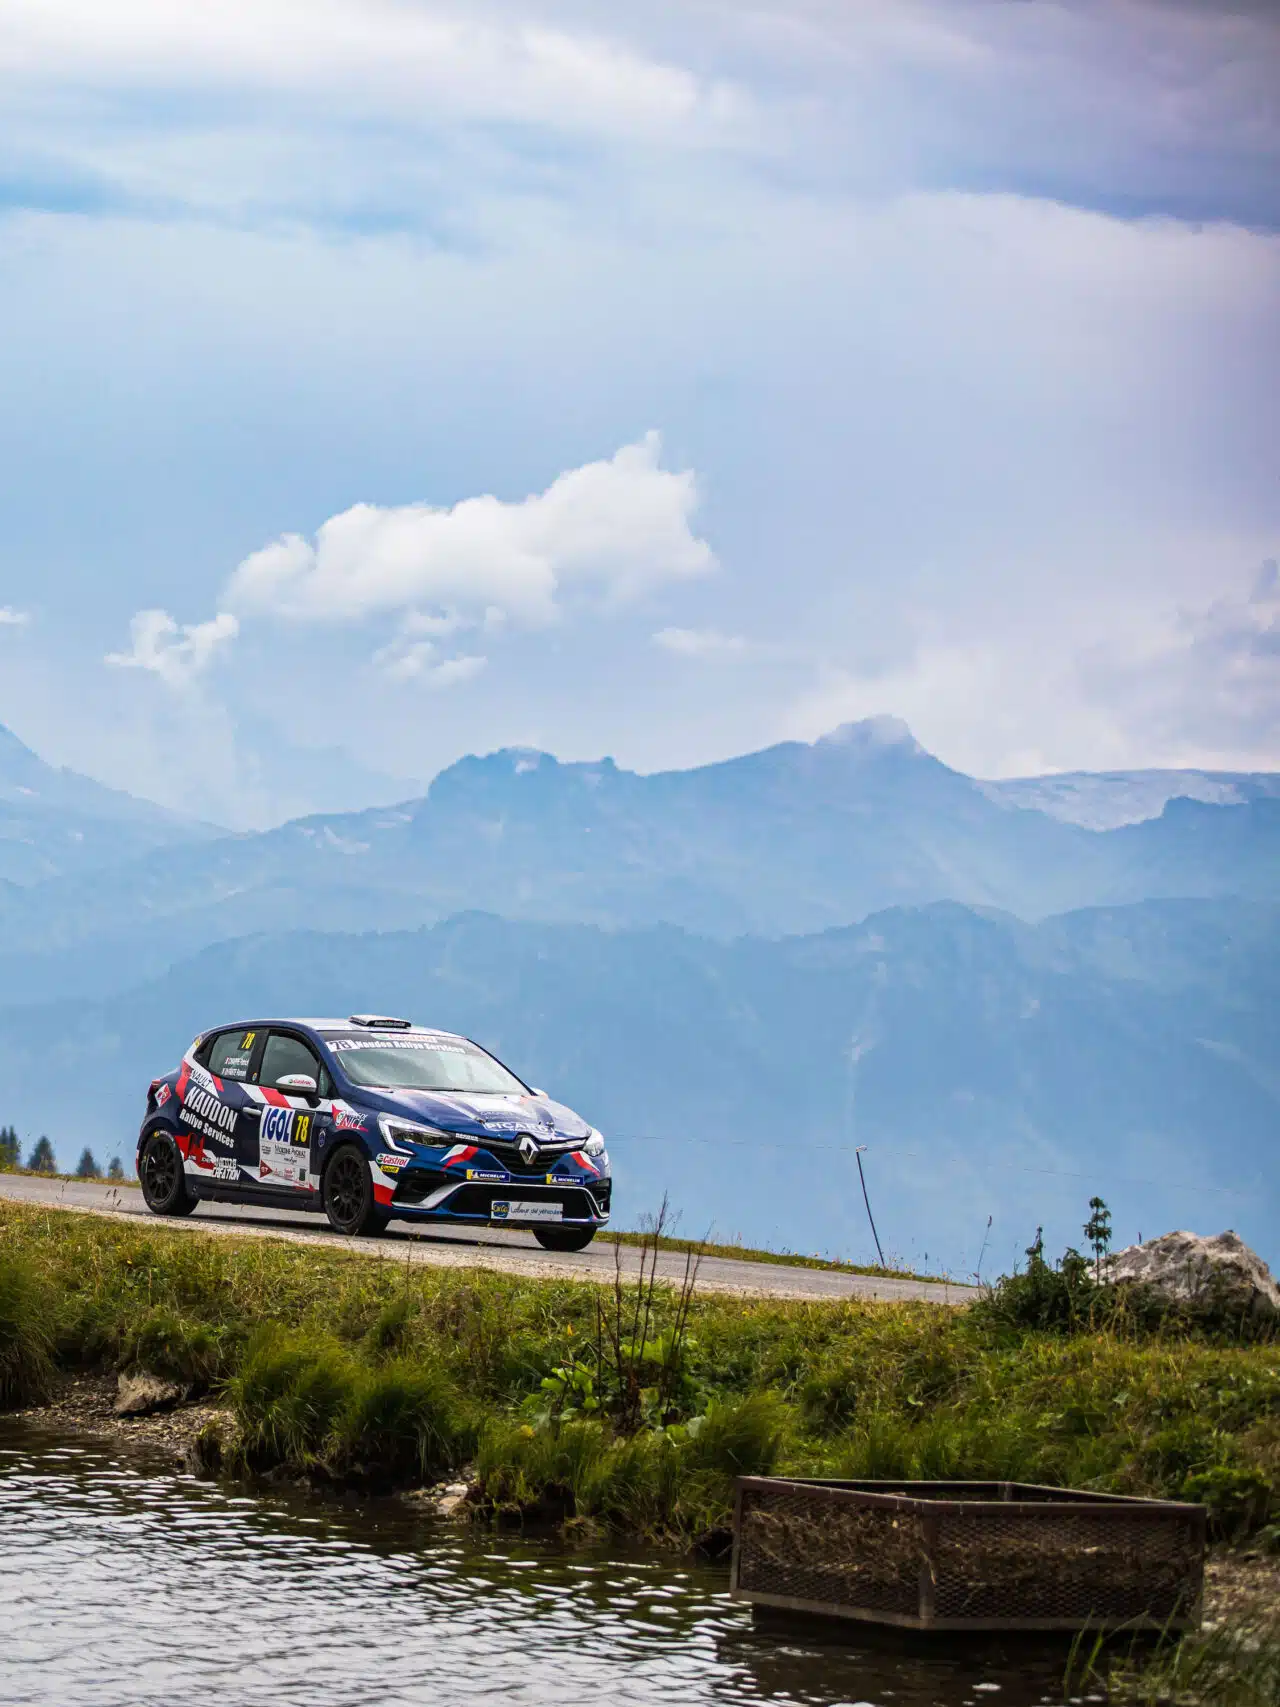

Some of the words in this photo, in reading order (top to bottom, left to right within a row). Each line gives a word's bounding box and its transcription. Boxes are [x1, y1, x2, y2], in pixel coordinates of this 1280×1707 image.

[241, 1032, 256, 1049] 78
[330, 1040, 351, 1050] 78
[356, 1040, 394, 1049] Naudon
[394, 1040, 423, 1050] Rallye
[184, 1086, 238, 1133] NAUDON
[179, 1108, 203, 1130] Rallye
[202, 1122, 235, 1148] Services
[262, 1108, 294, 1143] IGOL
[295, 1115, 310, 1143] 78
[384, 1155, 408, 1166] Castrol
